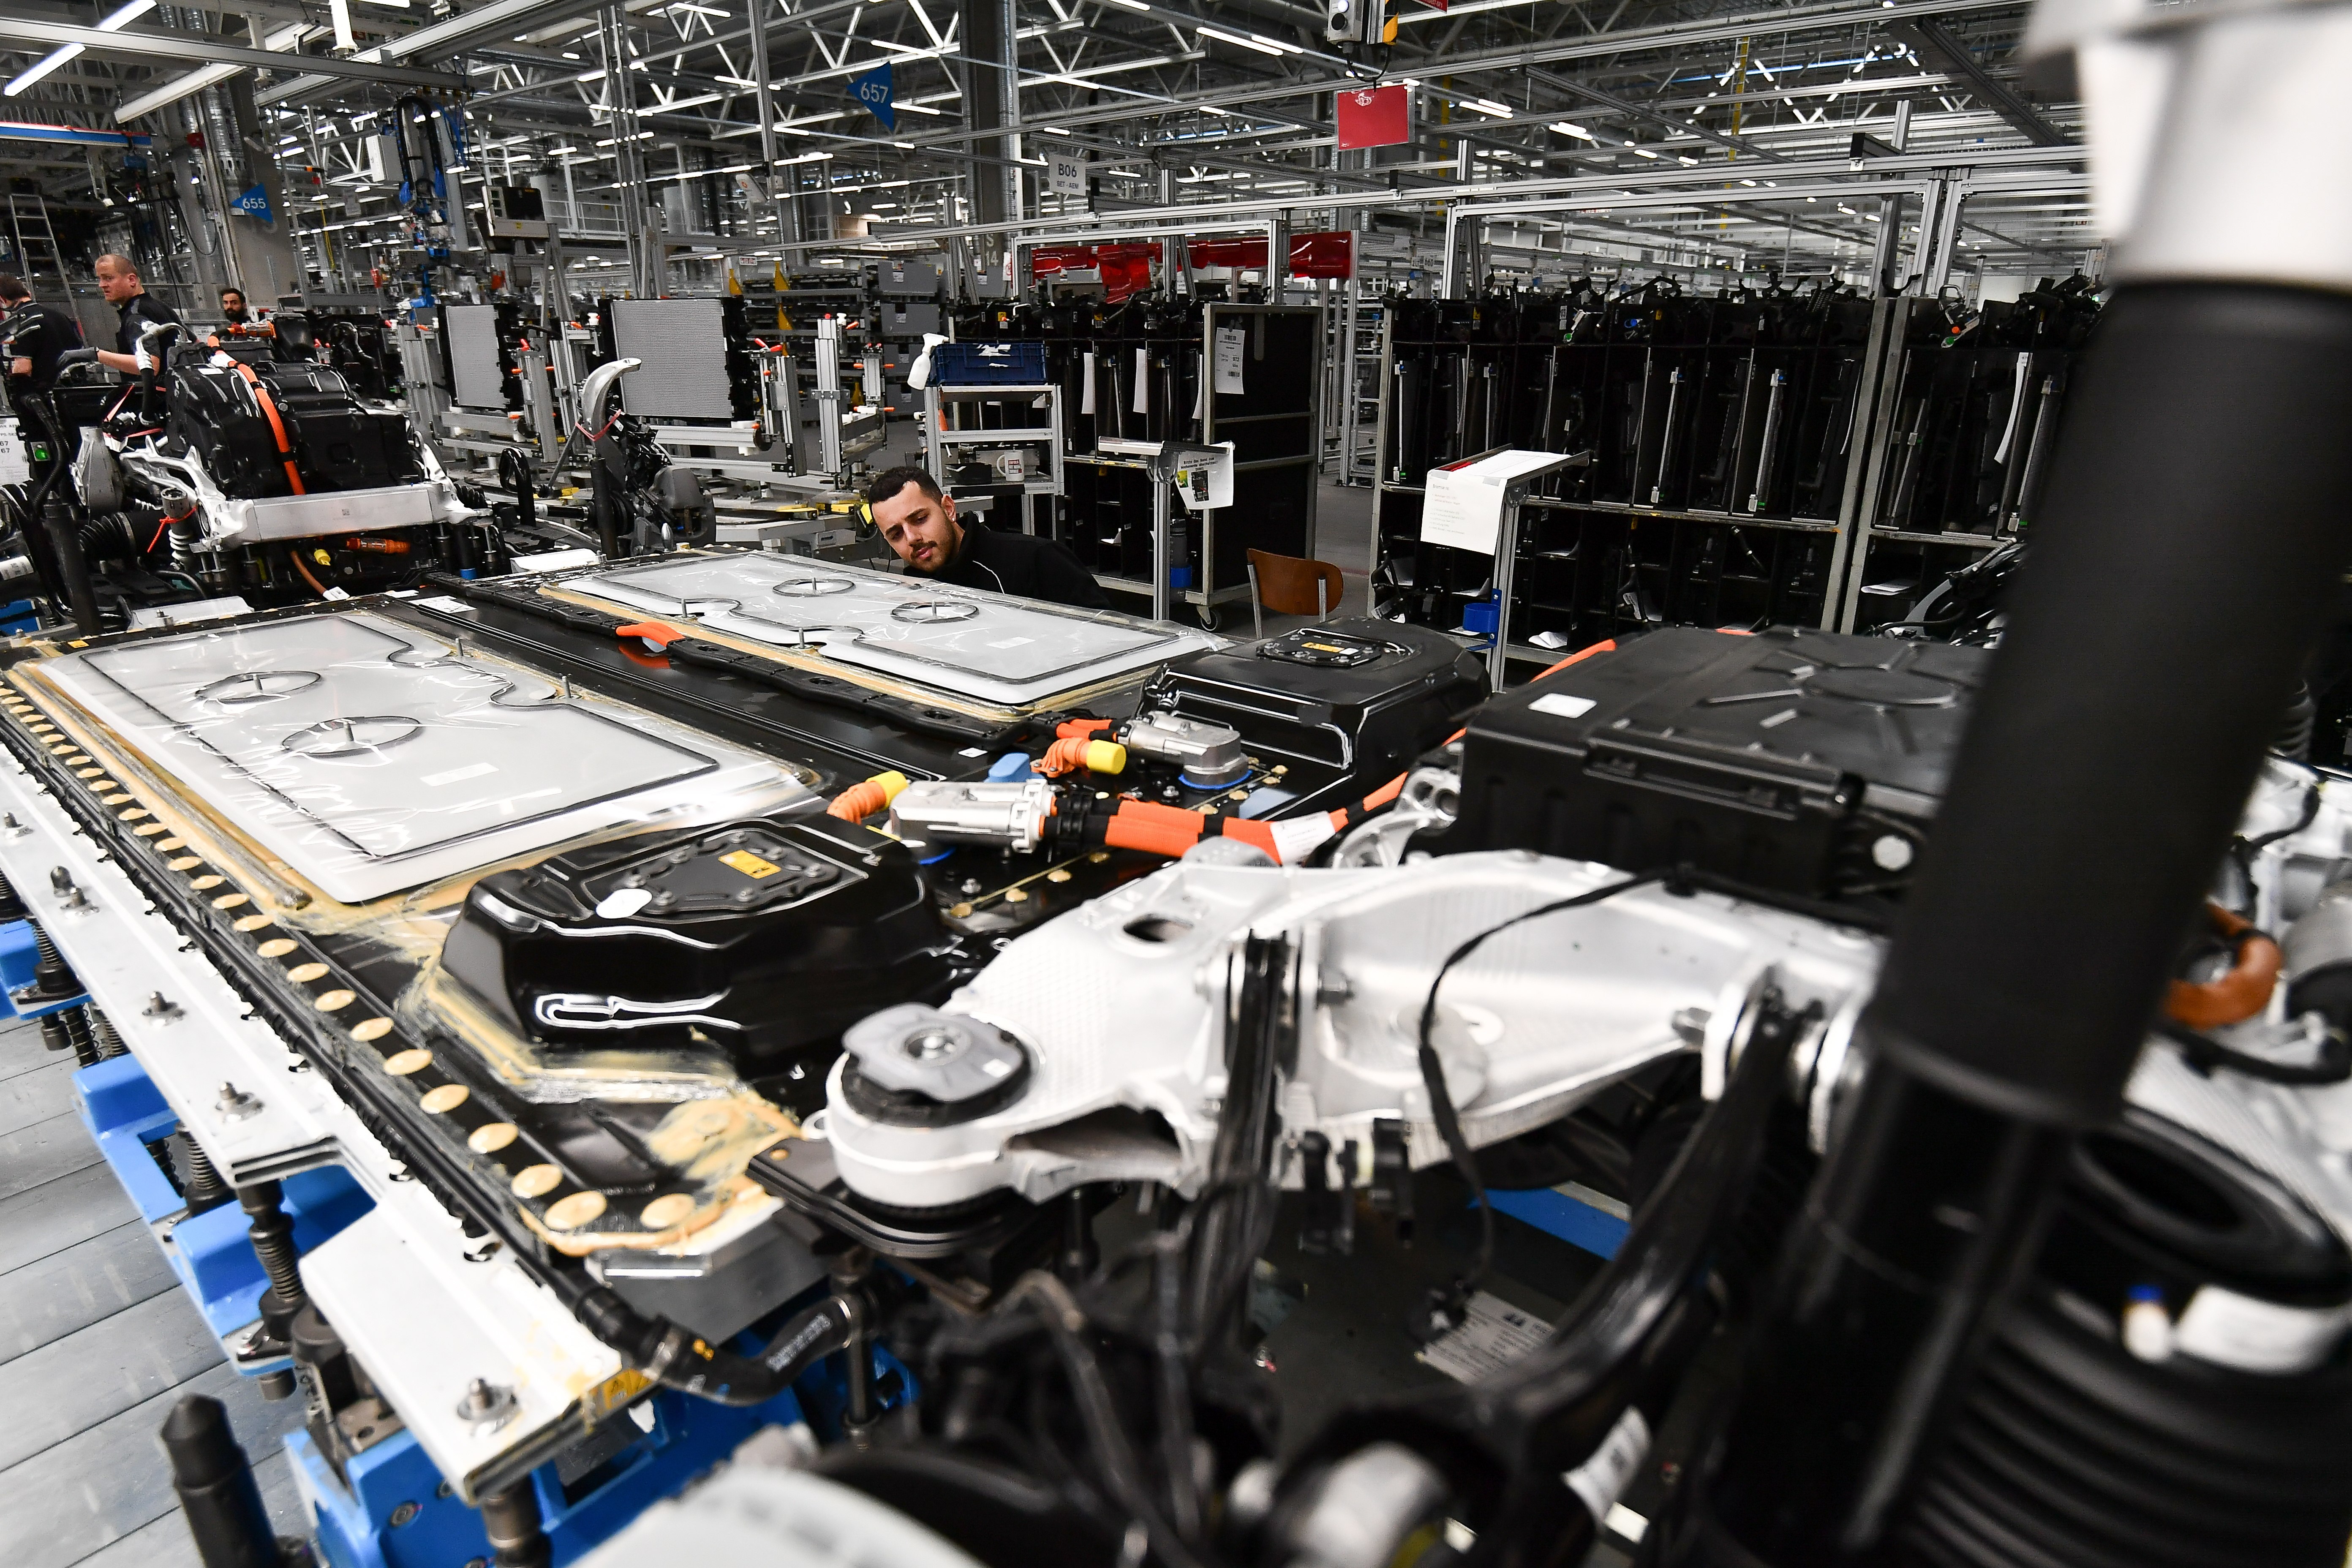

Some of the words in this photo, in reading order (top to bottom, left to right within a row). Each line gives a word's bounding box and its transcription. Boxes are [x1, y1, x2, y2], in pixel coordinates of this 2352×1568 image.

[860, 82, 889, 103] 657
[1059, 163, 1077, 177] B06
[242, 198, 266, 209] 655
[985, 250, 999, 266] 14
